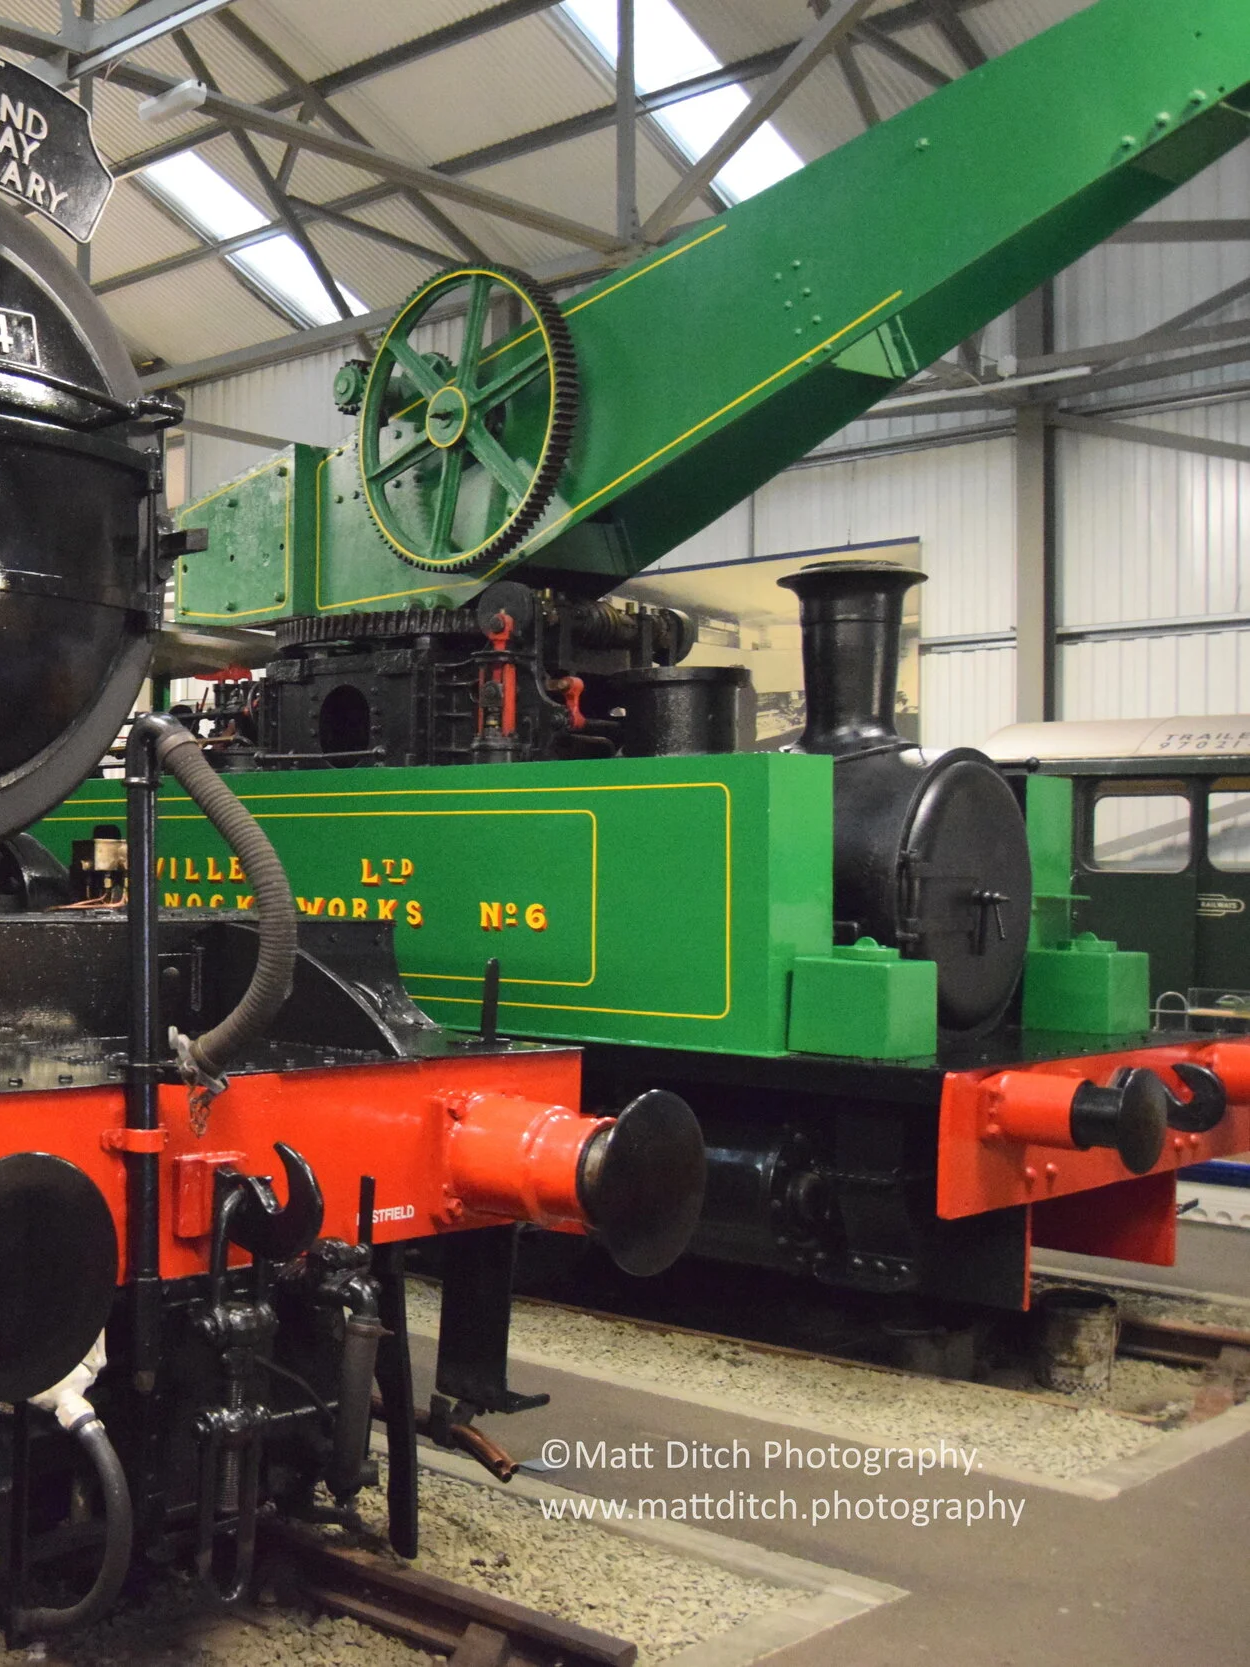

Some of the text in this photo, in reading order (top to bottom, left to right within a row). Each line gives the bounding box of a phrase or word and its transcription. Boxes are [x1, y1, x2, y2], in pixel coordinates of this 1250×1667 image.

[1158, 740, 1250, 750] 97021
[360, 858, 415, 887] LTD
[295, 896, 424, 929] WORKS
[525, 902, 548, 932] 6
[356, 1204, 414, 1226] STFIELD
